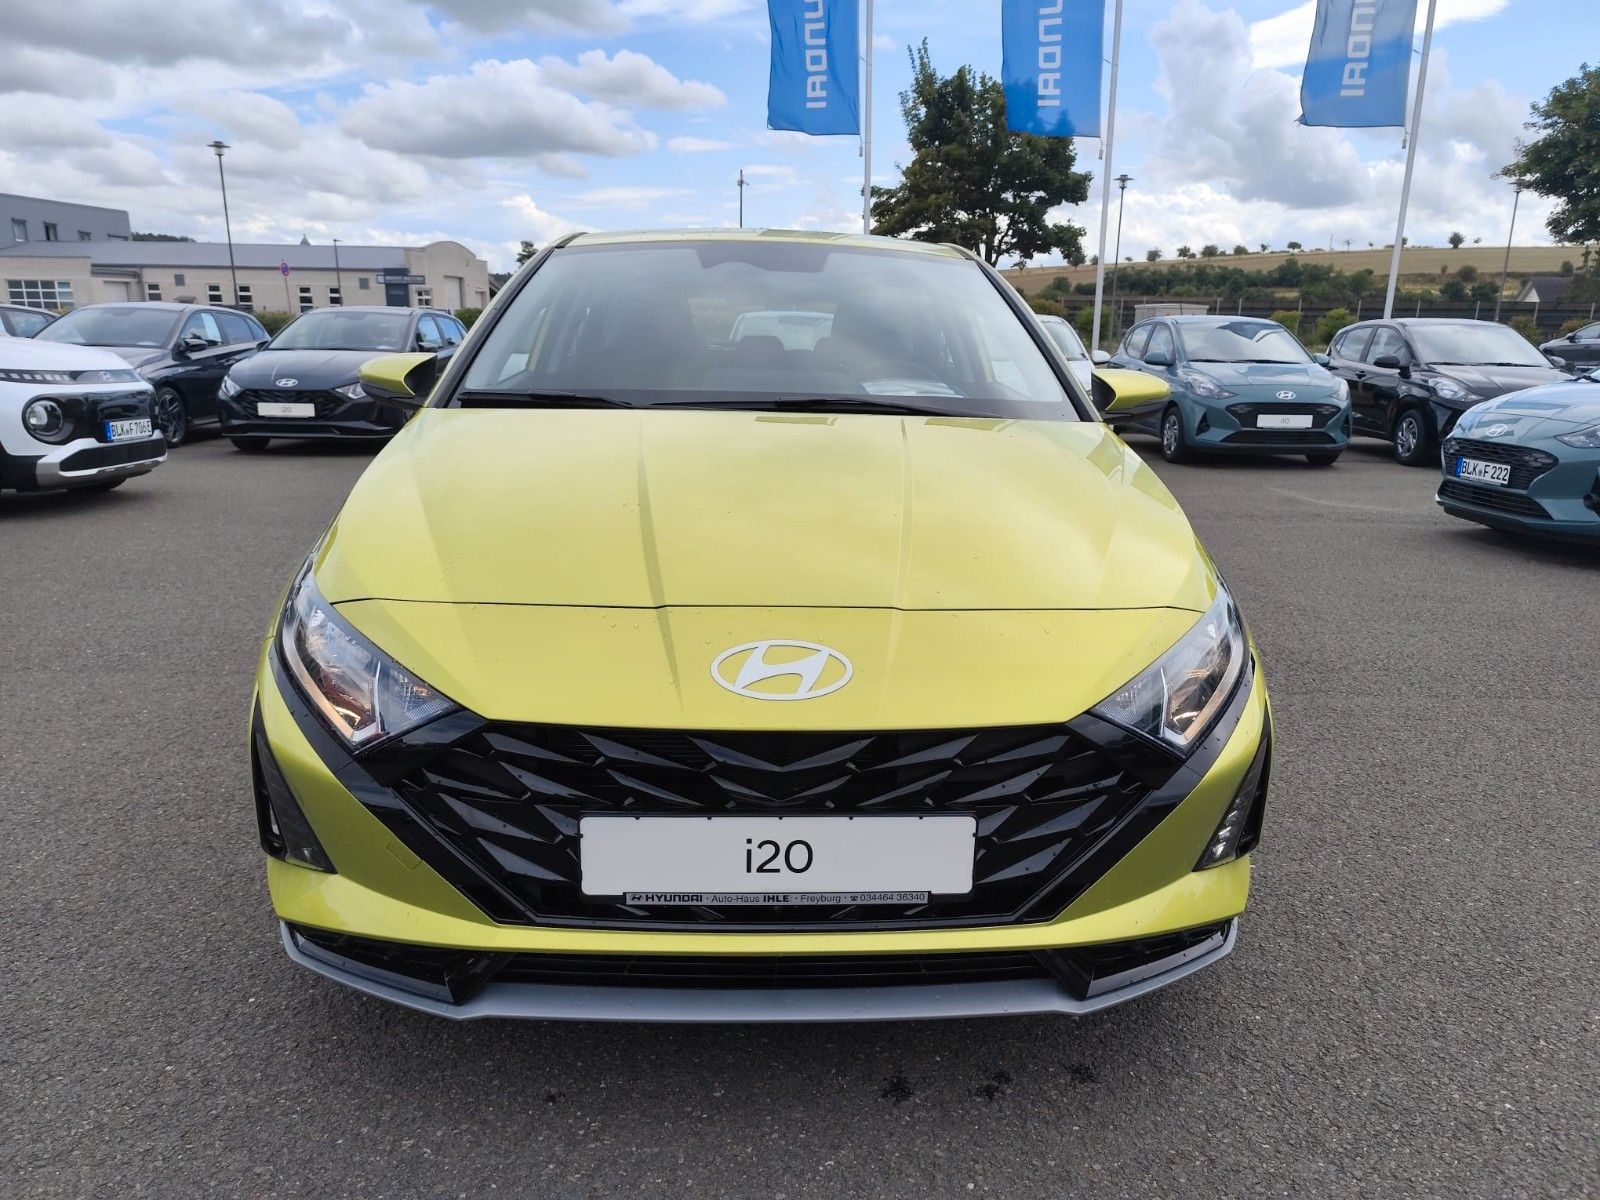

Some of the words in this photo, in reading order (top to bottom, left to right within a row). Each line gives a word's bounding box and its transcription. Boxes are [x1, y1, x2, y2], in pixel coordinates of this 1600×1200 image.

[111, 422, 125, 437] BLK
[1462, 460, 1478, 476] BLK
[746, 838, 814, 873] i20
[645, 894, 703, 903] HYUNDAI
[711, 894, 760, 903] Auto-Haus
[763, 894, 790, 903] IHLE
[800, 894, 841, 904] Freyburg
[860, 893, 894, 901] 034464
[896, 893, 925, 901] 36340
